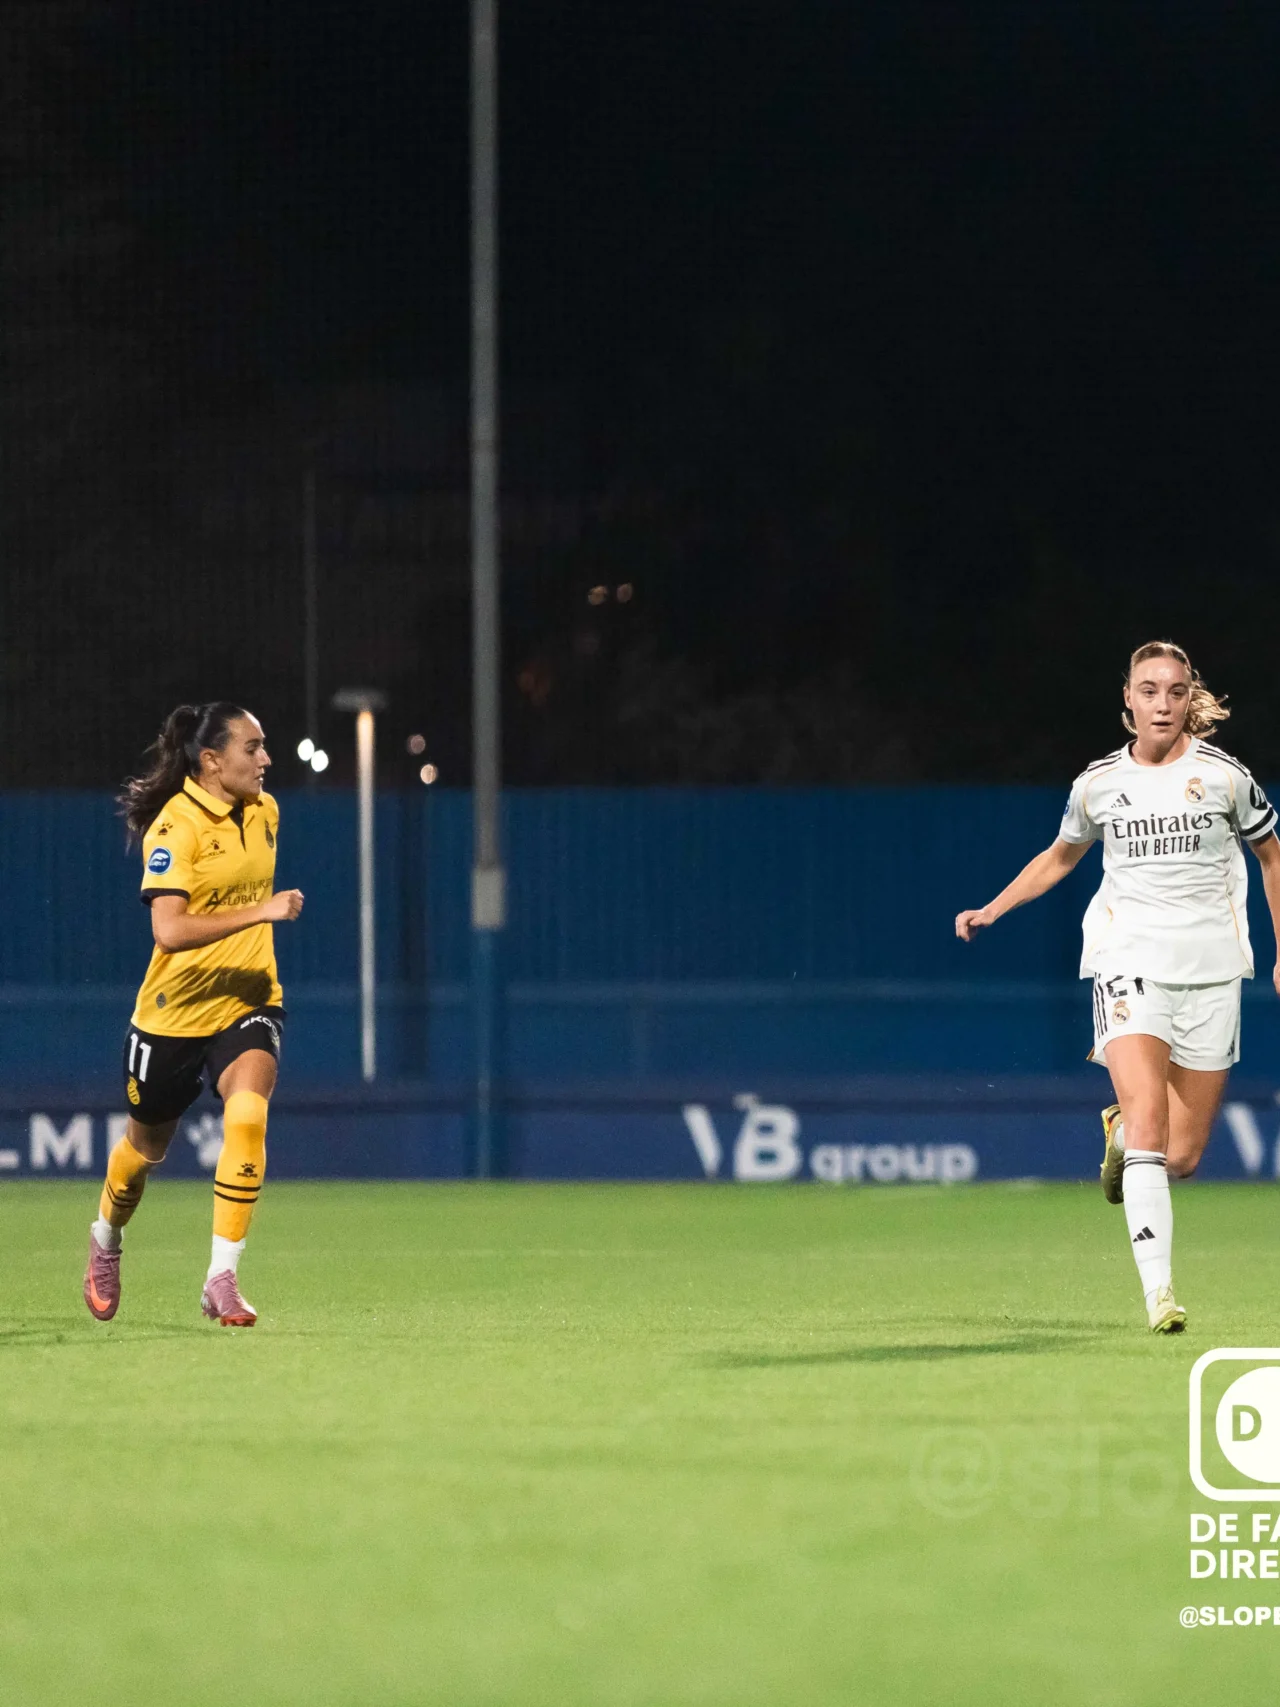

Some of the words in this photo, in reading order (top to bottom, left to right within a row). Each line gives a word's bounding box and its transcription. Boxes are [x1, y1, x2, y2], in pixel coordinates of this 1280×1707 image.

[1112, 812, 1212, 839] Emirates
[1128, 842, 1148, 858] FLY
[1153, 835, 1200, 855] BETTER
[128, 1033, 152, 1083] 11
[809, 1143, 979, 1186] group
